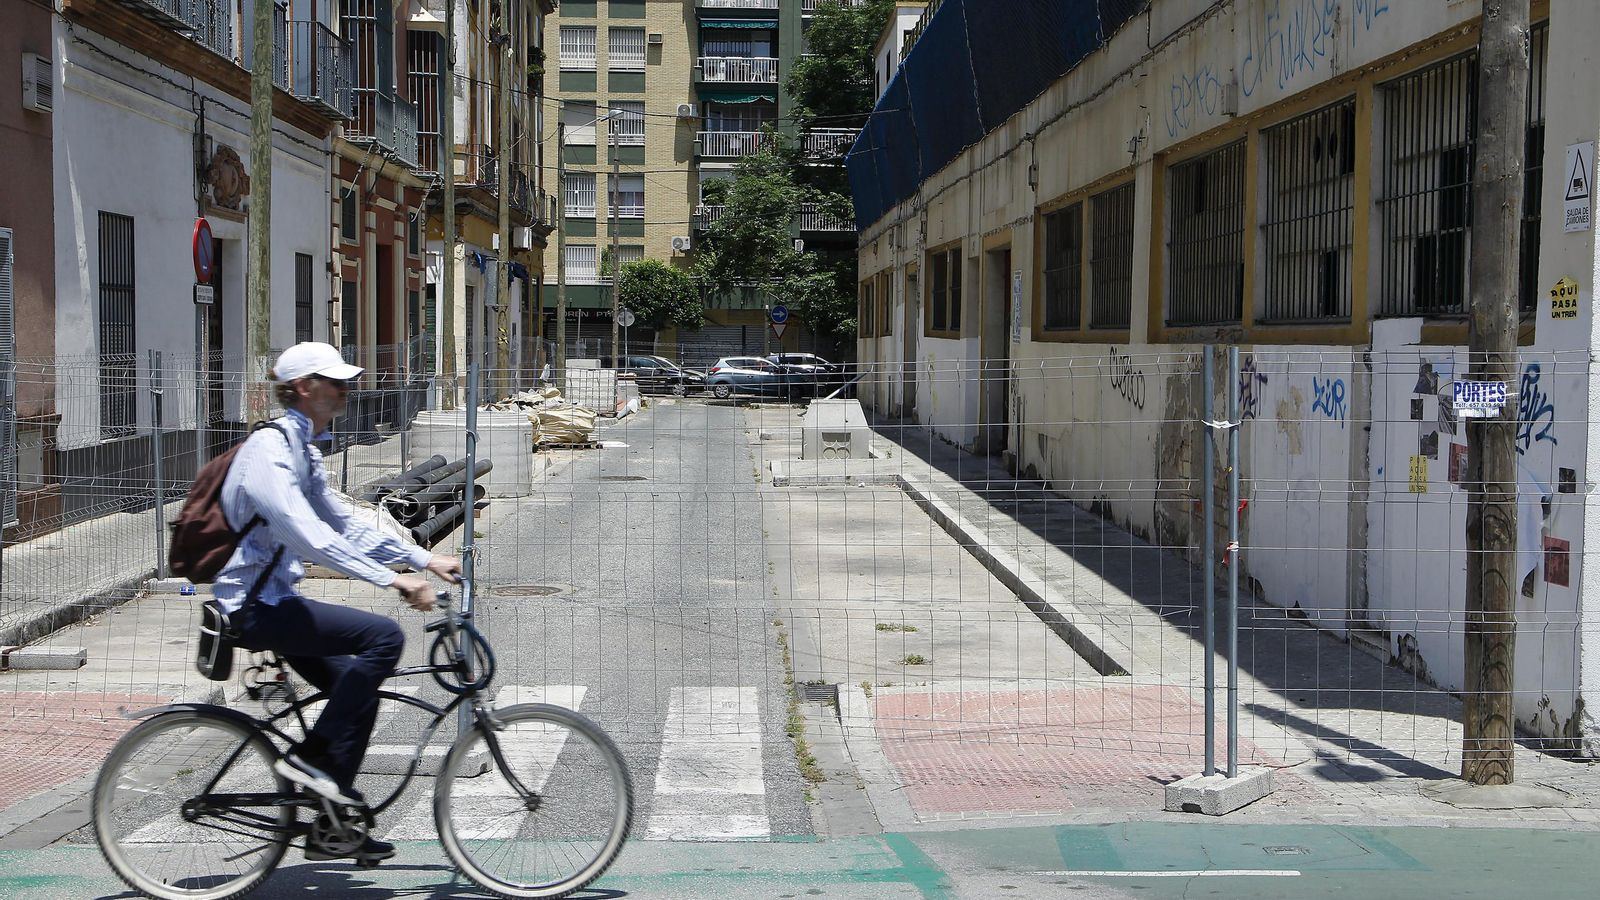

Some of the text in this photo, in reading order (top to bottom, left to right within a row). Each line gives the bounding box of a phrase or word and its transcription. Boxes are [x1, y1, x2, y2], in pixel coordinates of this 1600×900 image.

[1566, 206, 1589, 217] SALIDA DE
[1552, 299, 1577, 309] PASA
[1551, 310, 1577, 319] UN TREN
[1453, 382, 1505, 402] PORTES
